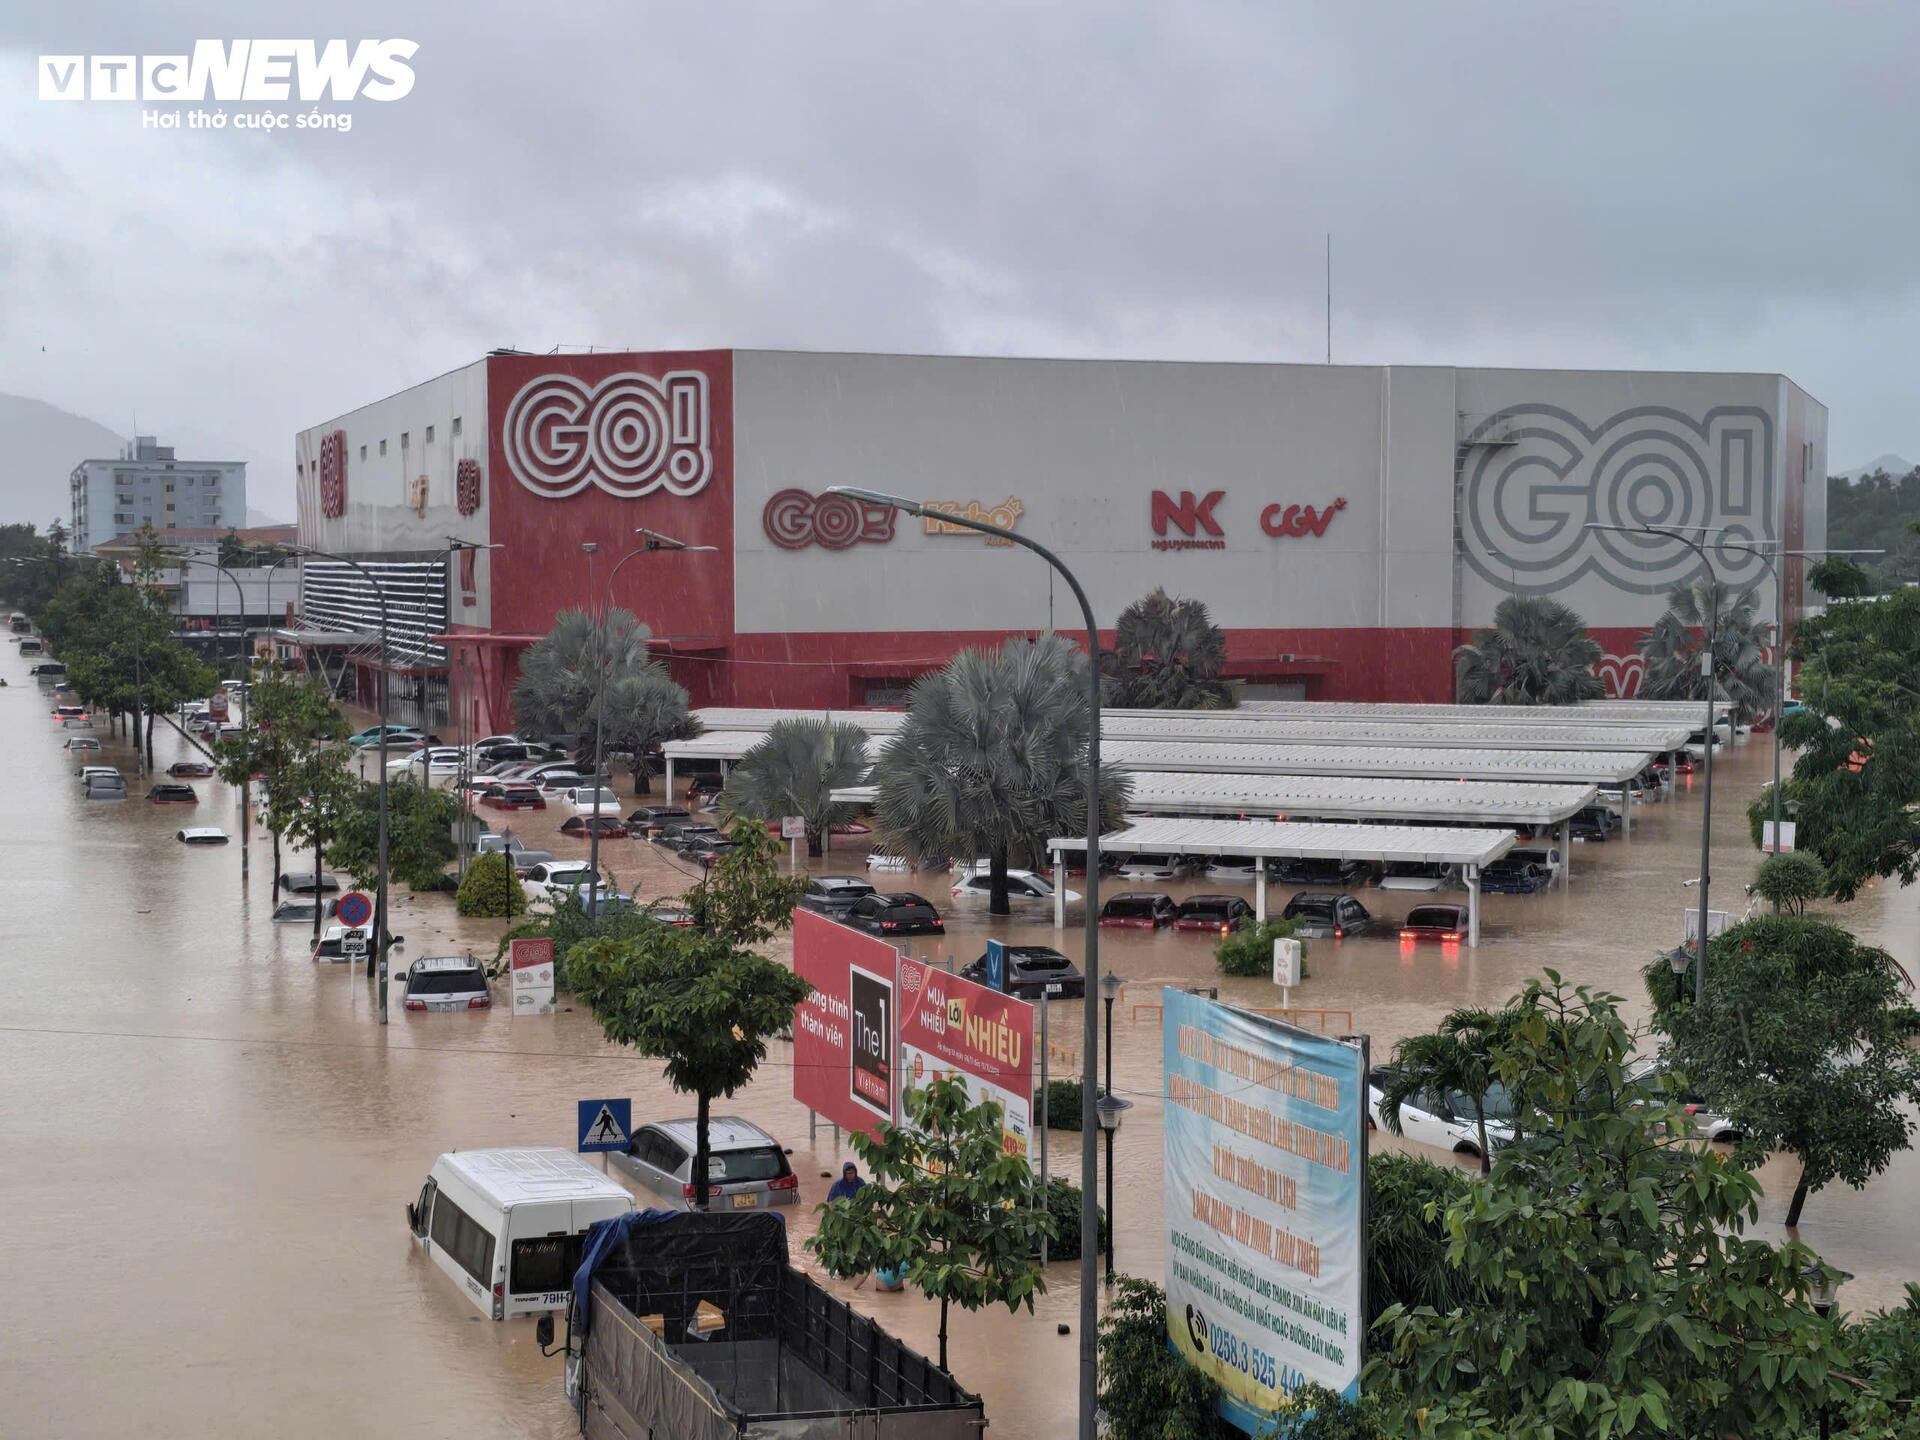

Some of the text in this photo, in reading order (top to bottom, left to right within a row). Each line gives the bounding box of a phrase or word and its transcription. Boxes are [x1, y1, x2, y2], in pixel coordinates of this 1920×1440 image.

[503, 370, 713, 499] GO!
[1152, 490, 1226, 537] NK
[1260, 502, 1338, 538] CGV
[1456, 403, 1774, 596] GO!
[829, 993, 849, 1020] trình
[927, 987, 946, 1009] MUA
[801, 1009, 843, 1048] thành viên
[920, 1008, 946, 1036] NHIỀU
[965, 1008, 1021, 1068] NHIỀU
[858, 1072, 886, 1099] Vietnam
[1181, 1233, 1195, 1256] CÔNG
[1195, 1241, 1206, 1262] DÂN
[1215, 1253, 1227, 1273] PHÁT
[1239, 1269, 1256, 1290] NGƯỜI
[1256, 1278, 1271, 1298] LANG
[1272, 1284, 1292, 1309] THANG
[1292, 1293, 1303, 1315] XIN
[1303, 1295, 1312, 1319] ĂN
[1326, 1307, 1338, 1331] LIÊN
[1339, 1313, 1347, 1339] HỆ
[1210, 1322, 1248, 1373] 0258.3
[1252, 1348, 1276, 1390] 525
[1271, 1316, 1289, 1341] HOẶC
[1290, 1324, 1311, 1350] ĐƯỜNG
[1325, 1340, 1344, 1367] NÓNG:
